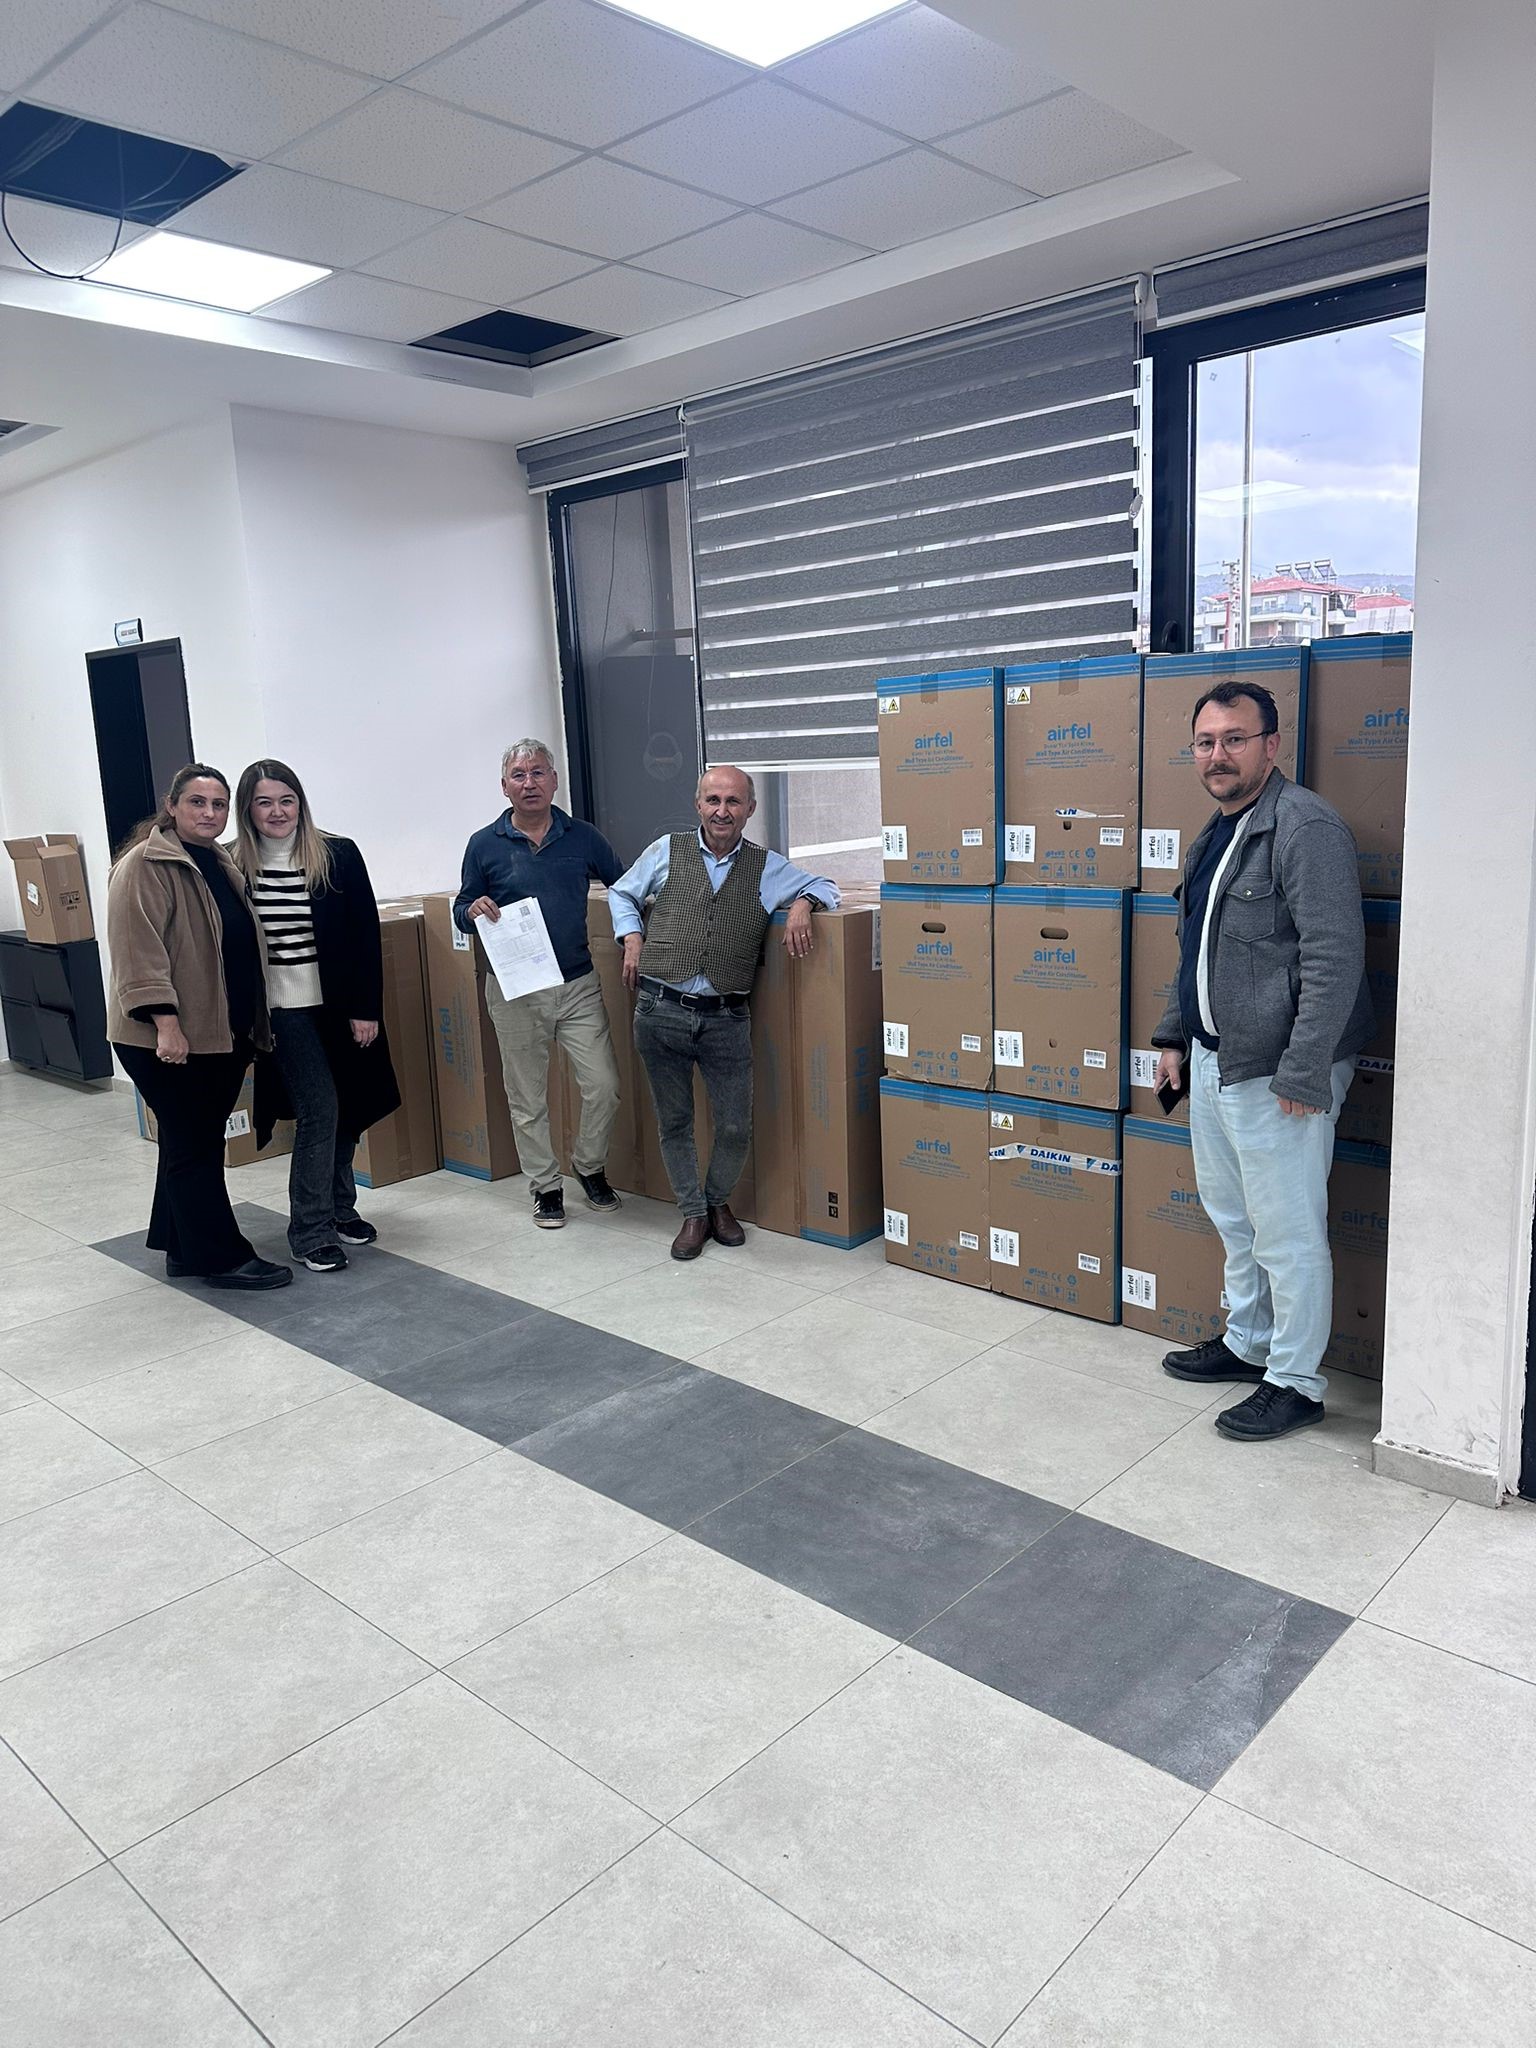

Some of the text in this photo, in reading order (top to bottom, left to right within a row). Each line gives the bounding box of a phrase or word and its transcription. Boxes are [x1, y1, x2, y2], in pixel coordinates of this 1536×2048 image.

[1047, 722, 1091, 741] airfel
[914, 731, 953, 750] airfel
[916, 941, 953, 956] airfel
[1033, 948, 1076, 964] airfel
[439, 1007, 455, 1065] airfel
[916, 1138, 951, 1155] airfel
[1030, 1148, 1072, 1163] DAIKIN
[1192, 1312, 1204, 1321] CE
